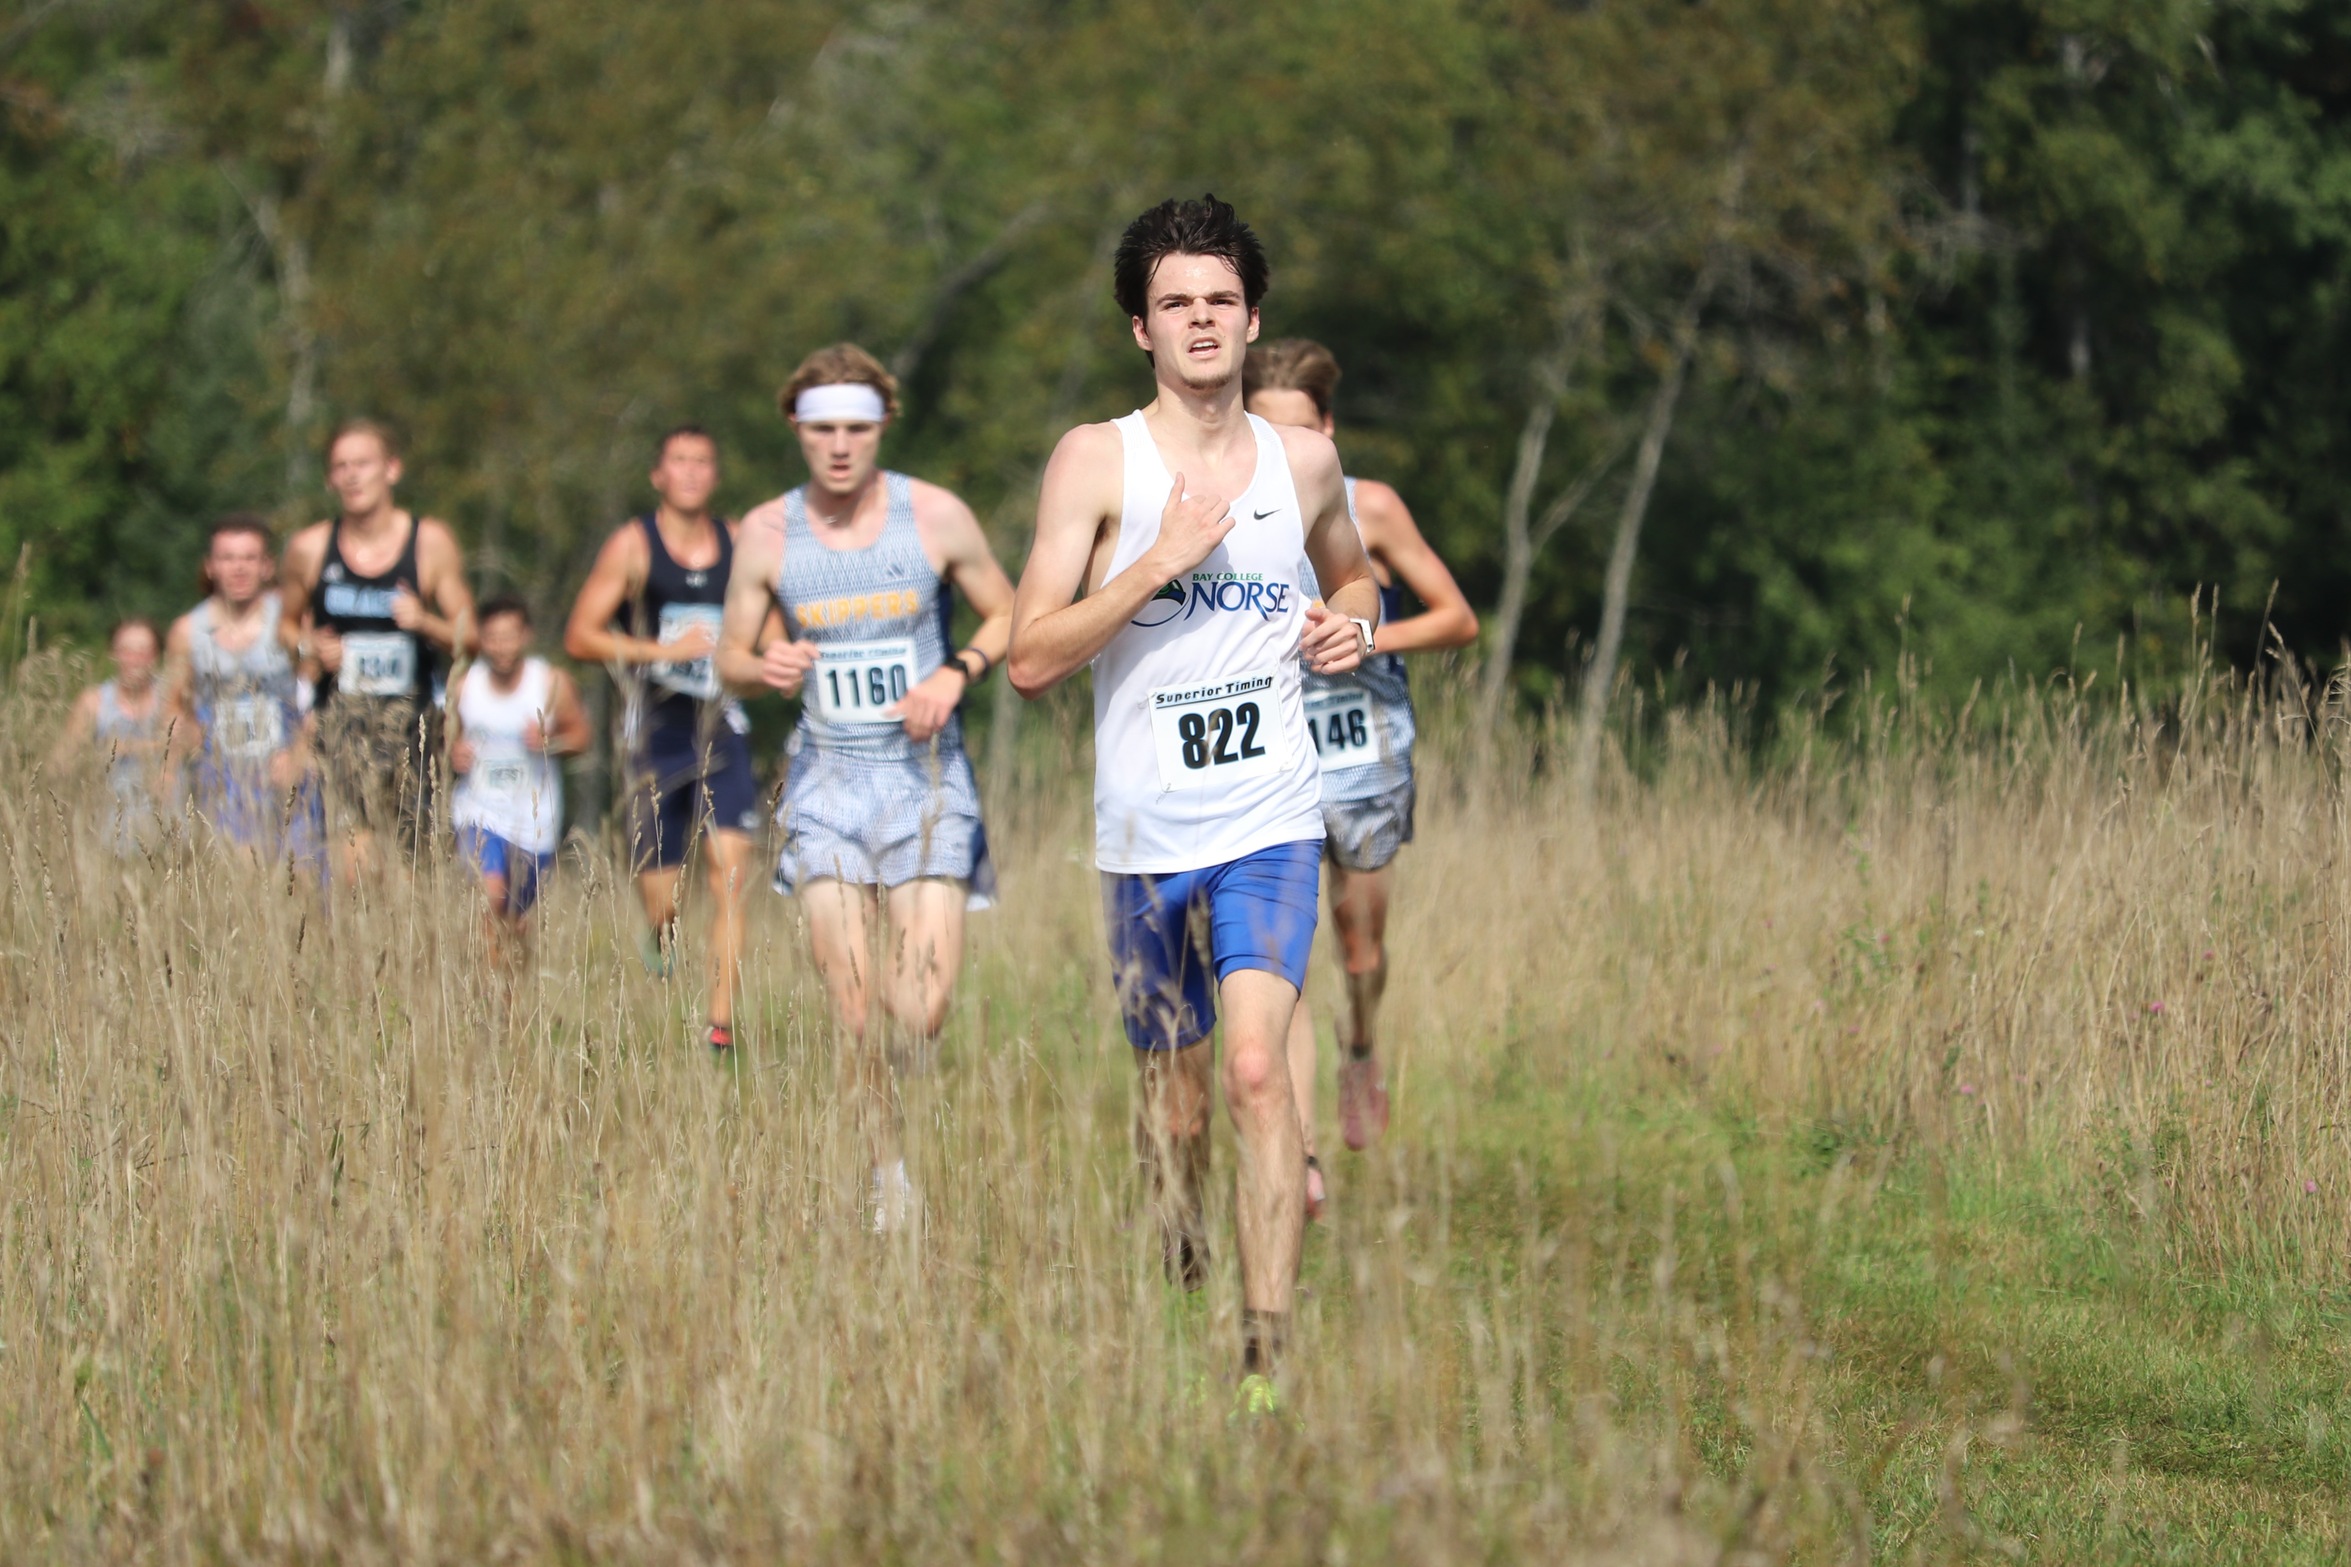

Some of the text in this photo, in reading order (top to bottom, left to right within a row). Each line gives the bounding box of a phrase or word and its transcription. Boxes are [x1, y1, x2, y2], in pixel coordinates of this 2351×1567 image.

[1193, 572, 1264, 581] BAY COLLEGE
[797, 589, 917, 628] SKIPPERS
[1184, 581, 1289, 621] NORSE
[825, 664, 908, 707] 1160
[1156, 676, 1274, 704] Superior Timing
[1178, 701, 1266, 770] 822
